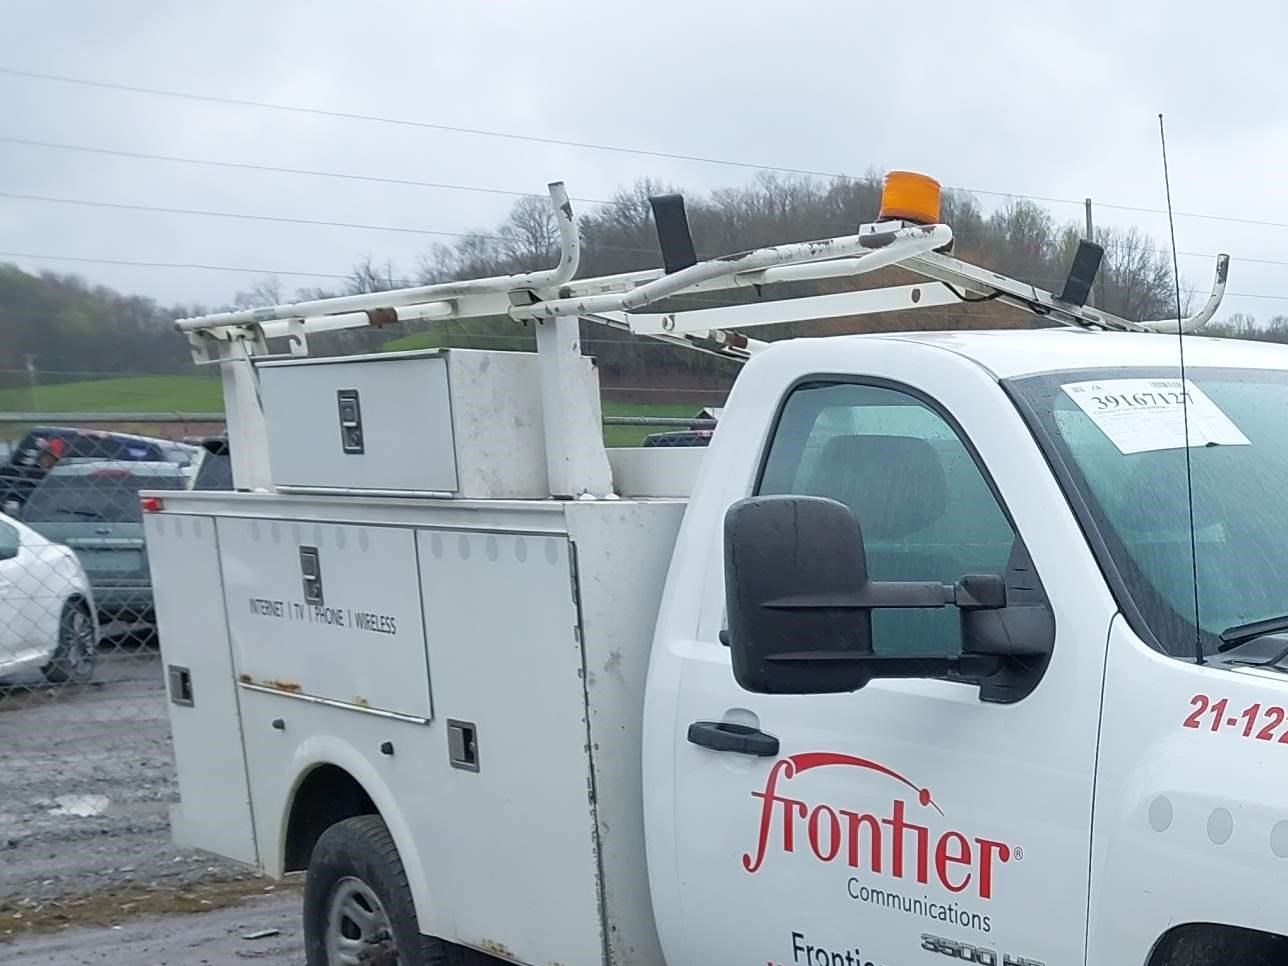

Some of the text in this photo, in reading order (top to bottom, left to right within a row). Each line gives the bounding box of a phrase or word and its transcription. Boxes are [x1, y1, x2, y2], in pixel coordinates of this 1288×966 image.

[1090, 392, 1195, 411] 39167127
[248, 598, 285, 618] INTERNET
[293, 602, 305, 621] TV
[314, 605, 345, 627] PHONE
[354, 611, 397, 635] WIRELESS
[742, 754, 1012, 900] frontier
[847, 876, 992, 933] Communications
